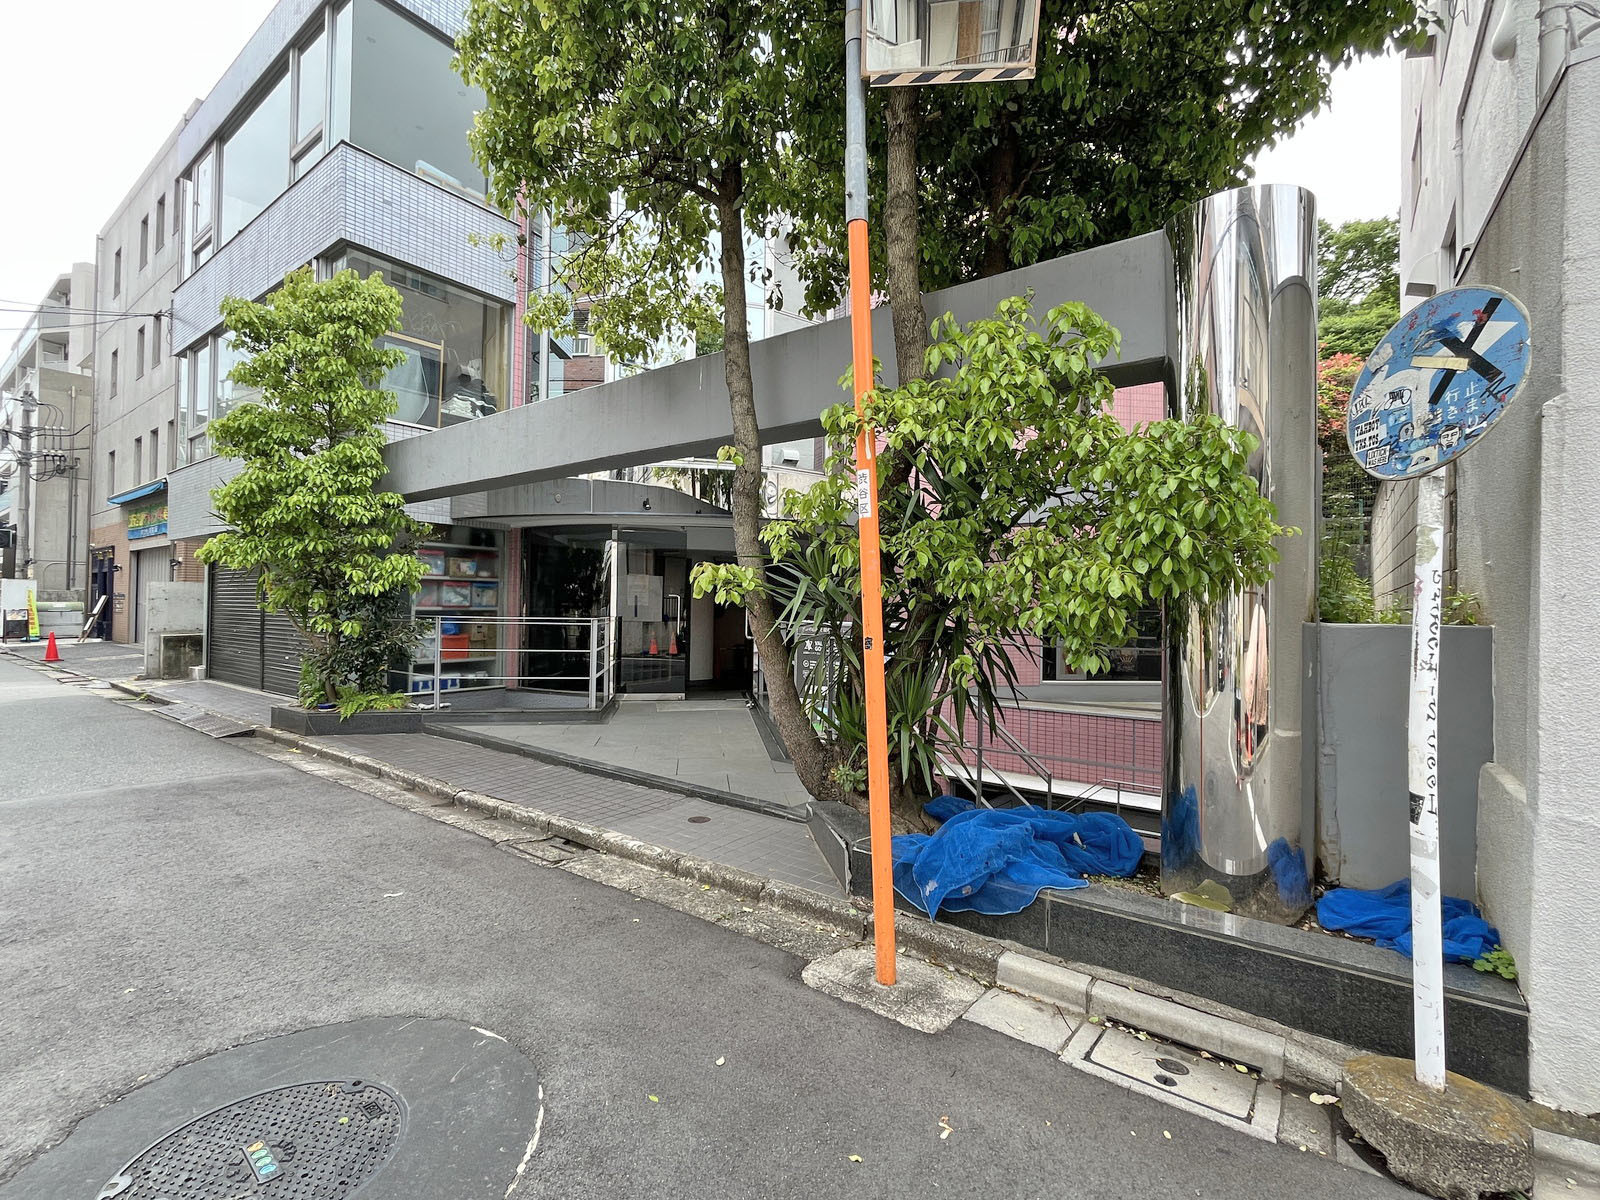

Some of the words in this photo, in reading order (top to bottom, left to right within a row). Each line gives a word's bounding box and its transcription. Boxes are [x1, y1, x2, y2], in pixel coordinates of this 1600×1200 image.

[1444, 387, 1460, 419] 行き
[859, 472, 869, 514] 渋谷区
